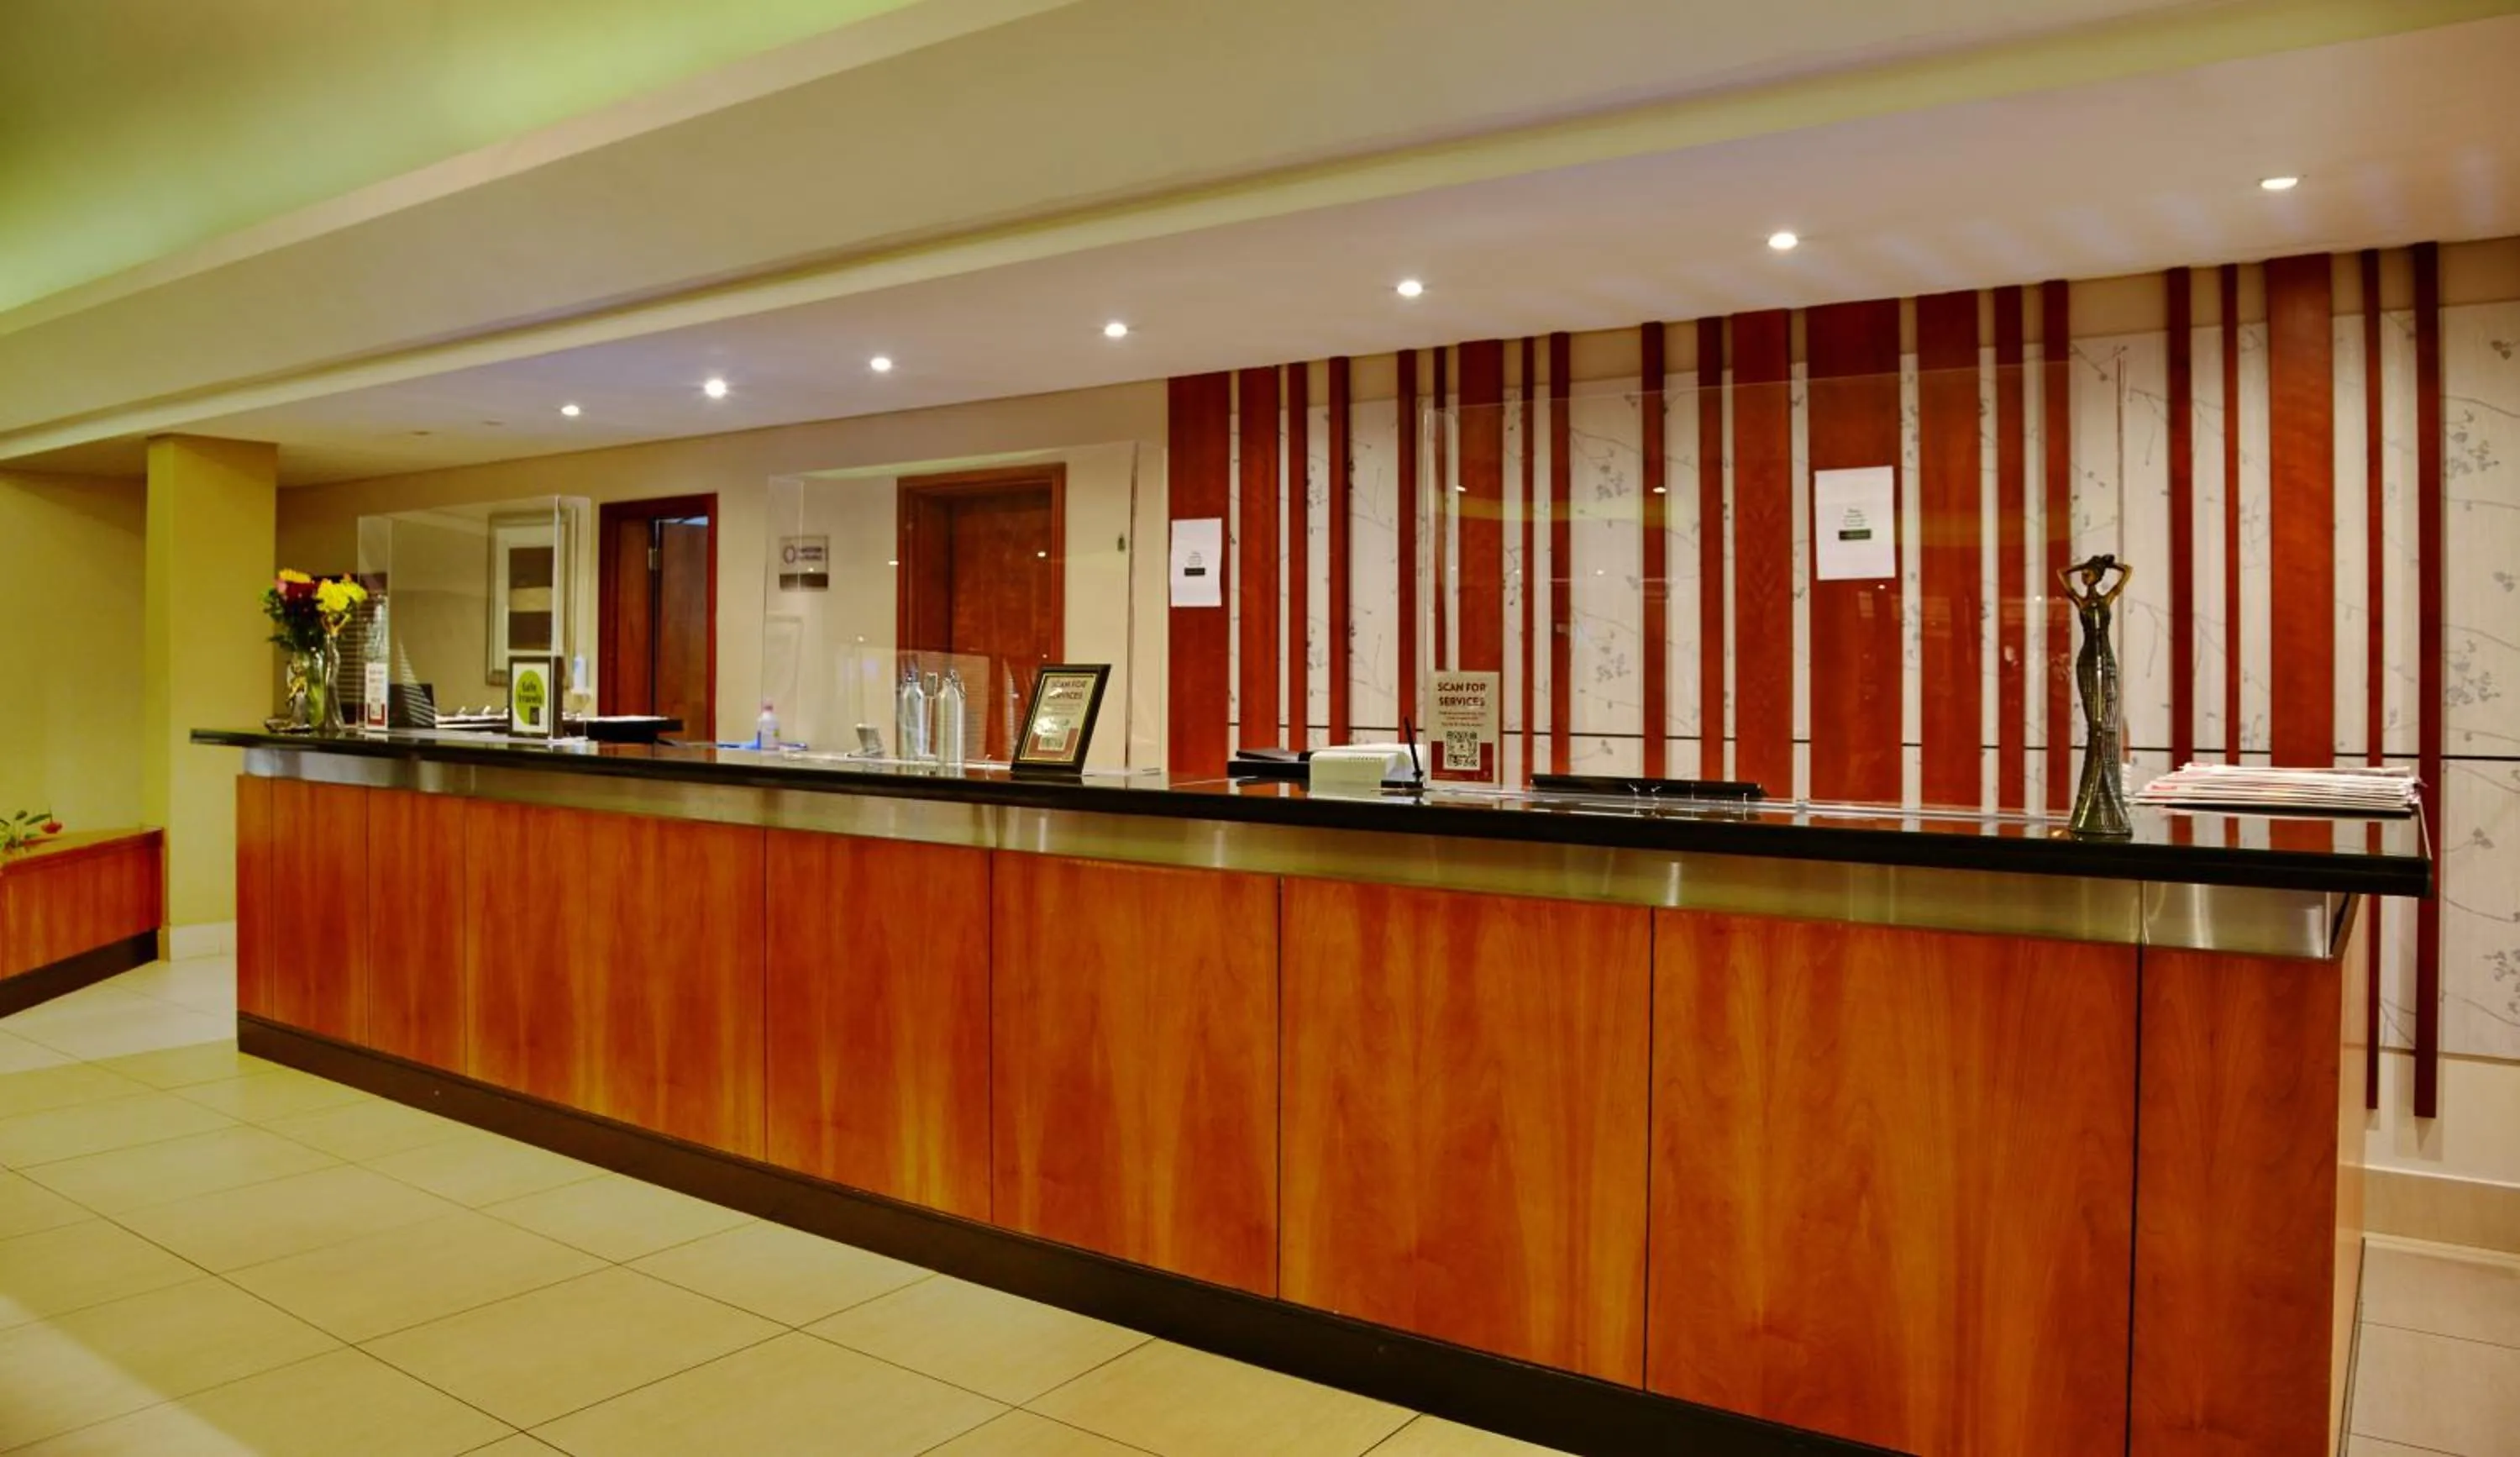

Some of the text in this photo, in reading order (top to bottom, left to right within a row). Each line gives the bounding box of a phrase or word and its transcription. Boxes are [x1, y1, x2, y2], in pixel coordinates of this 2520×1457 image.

[1437, 681, 1486, 692] SCAN FOR
[1439, 696, 1485, 707] SERVICES
